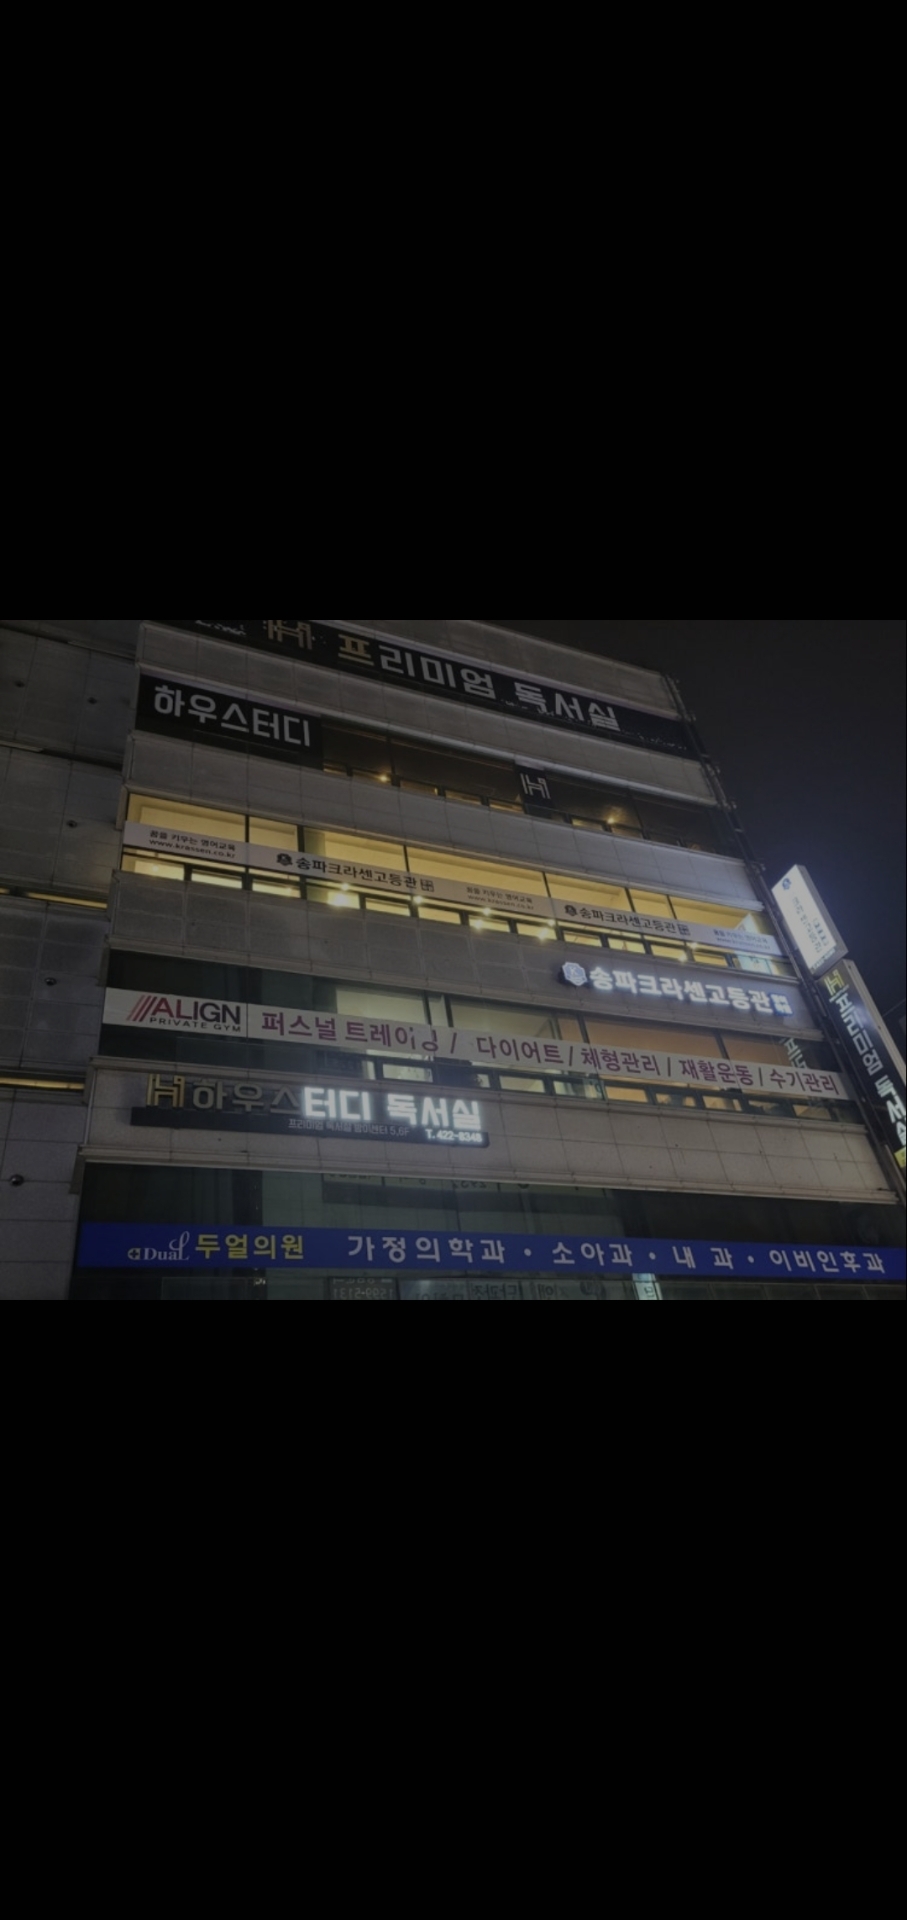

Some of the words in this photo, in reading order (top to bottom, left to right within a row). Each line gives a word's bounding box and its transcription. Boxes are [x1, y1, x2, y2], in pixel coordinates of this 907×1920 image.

[338, 633, 496, 700] 프리미엄
[514, 681, 621, 732] 독서실
[154, 685, 310, 747] 하우스터디
[149, 839, 236, 859] www.krassen.co.kr
[171, 833, 198, 846] 키우는
[201, 839, 236, 851] 영어교육
[296, 852, 418, 890] 송파크라센고등관
[579, 905, 677, 935] 송파크라센고등관
[150, 995, 241, 1025] ALIGN
[589, 966, 774, 1014] 송파크라센고등관
[149, 1016, 209, 1030] PRIVATE
[213, 1024, 242, 1033] GYM
[835, 991, 884, 1076] 프리미엄
[261, 1011, 336, 1037] 퍼스널
[477, 1036, 564, 1065] 다이어트
[581, 1047, 660, 1076] 체형관리
[681, 1059, 753, 1087] 재활운동
[769, 1067, 841, 1095] 수기관리
[192, 1079, 372, 1122] 하우스터디
[387, 1093, 482, 1131] 독서실
[288, 1118, 325, 1131] 프리미엄
[195, 1233, 304, 1260] 두얼의원
[347, 1235, 506, 1264] 가정의학과
[552, 1241, 633, 1267] 소아과
[768, 1249, 886, 1275] 이비인후과
